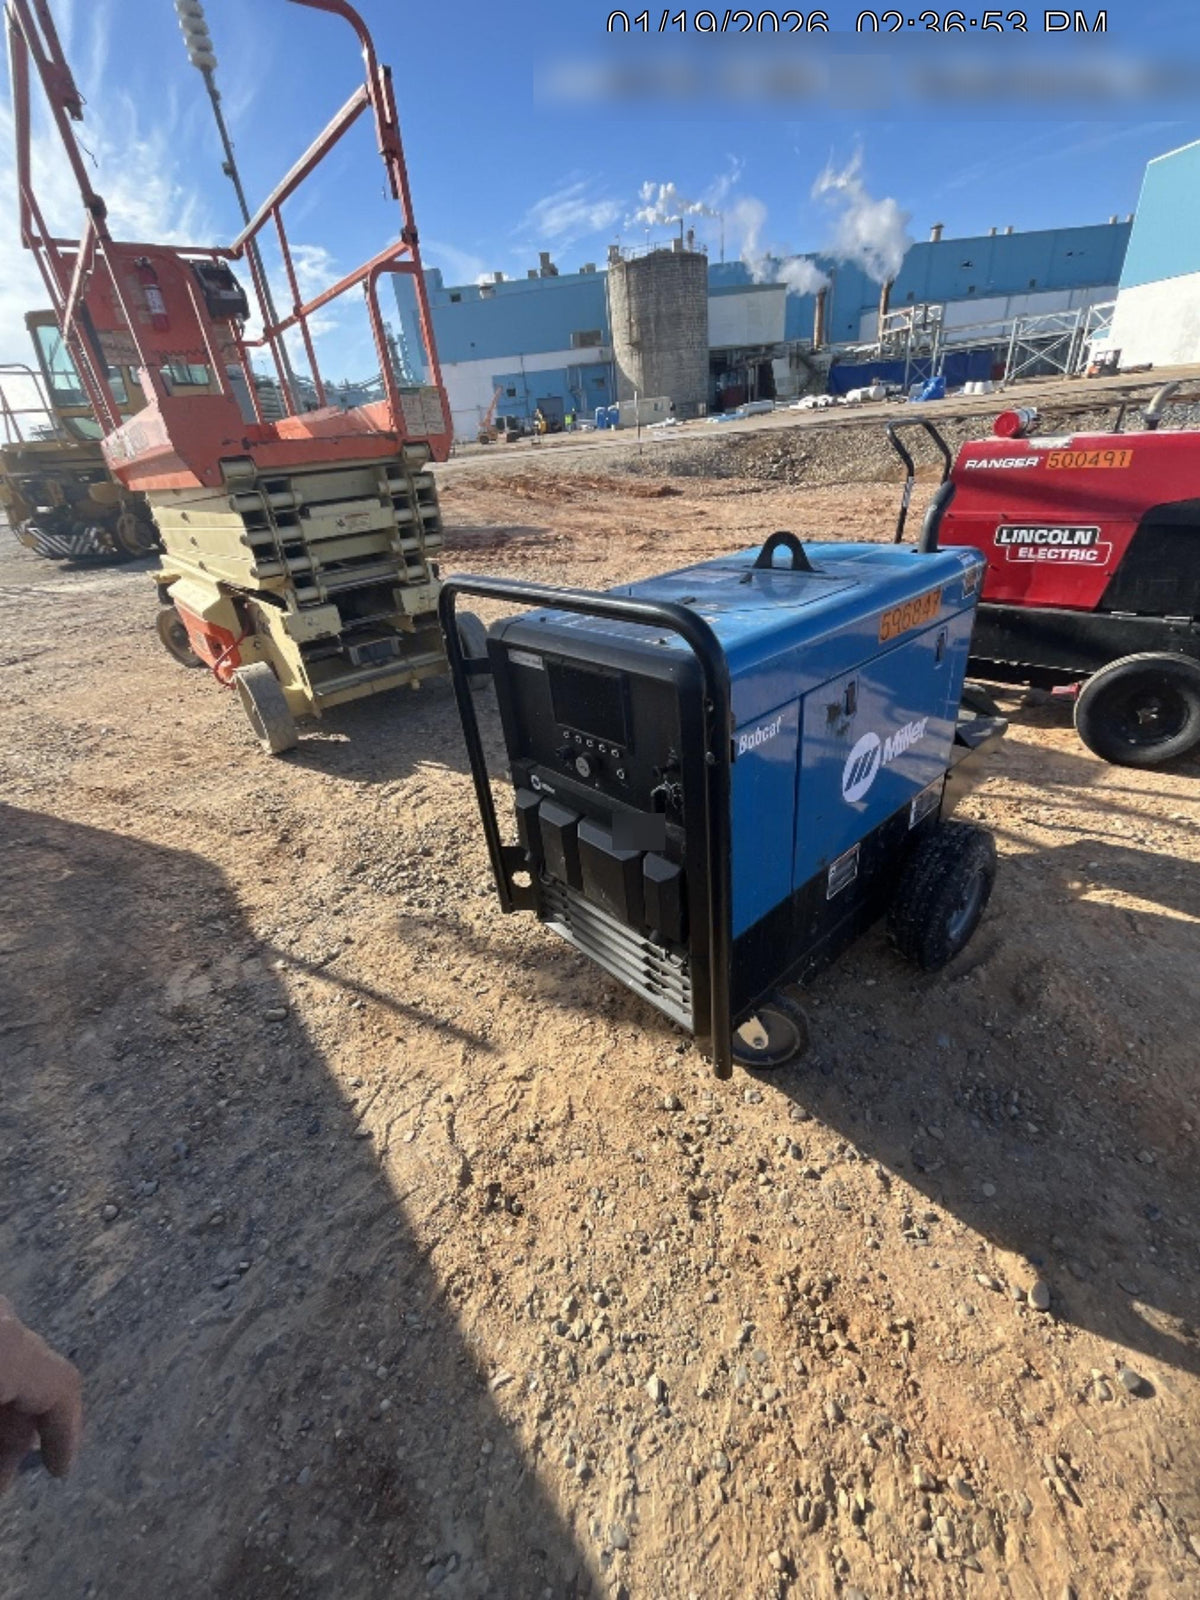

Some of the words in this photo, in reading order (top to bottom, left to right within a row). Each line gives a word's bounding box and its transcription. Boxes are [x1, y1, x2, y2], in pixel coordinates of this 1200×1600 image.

[965, 456, 1039, 470] RANGER
[1048, 450, 1127, 469] 500491
[1000, 529, 1093, 545] LINCOLN
[1018, 547, 1099, 561] ELECTRIC
[737, 715, 782, 757] Bobcat
[881, 716, 929, 766] Miller
